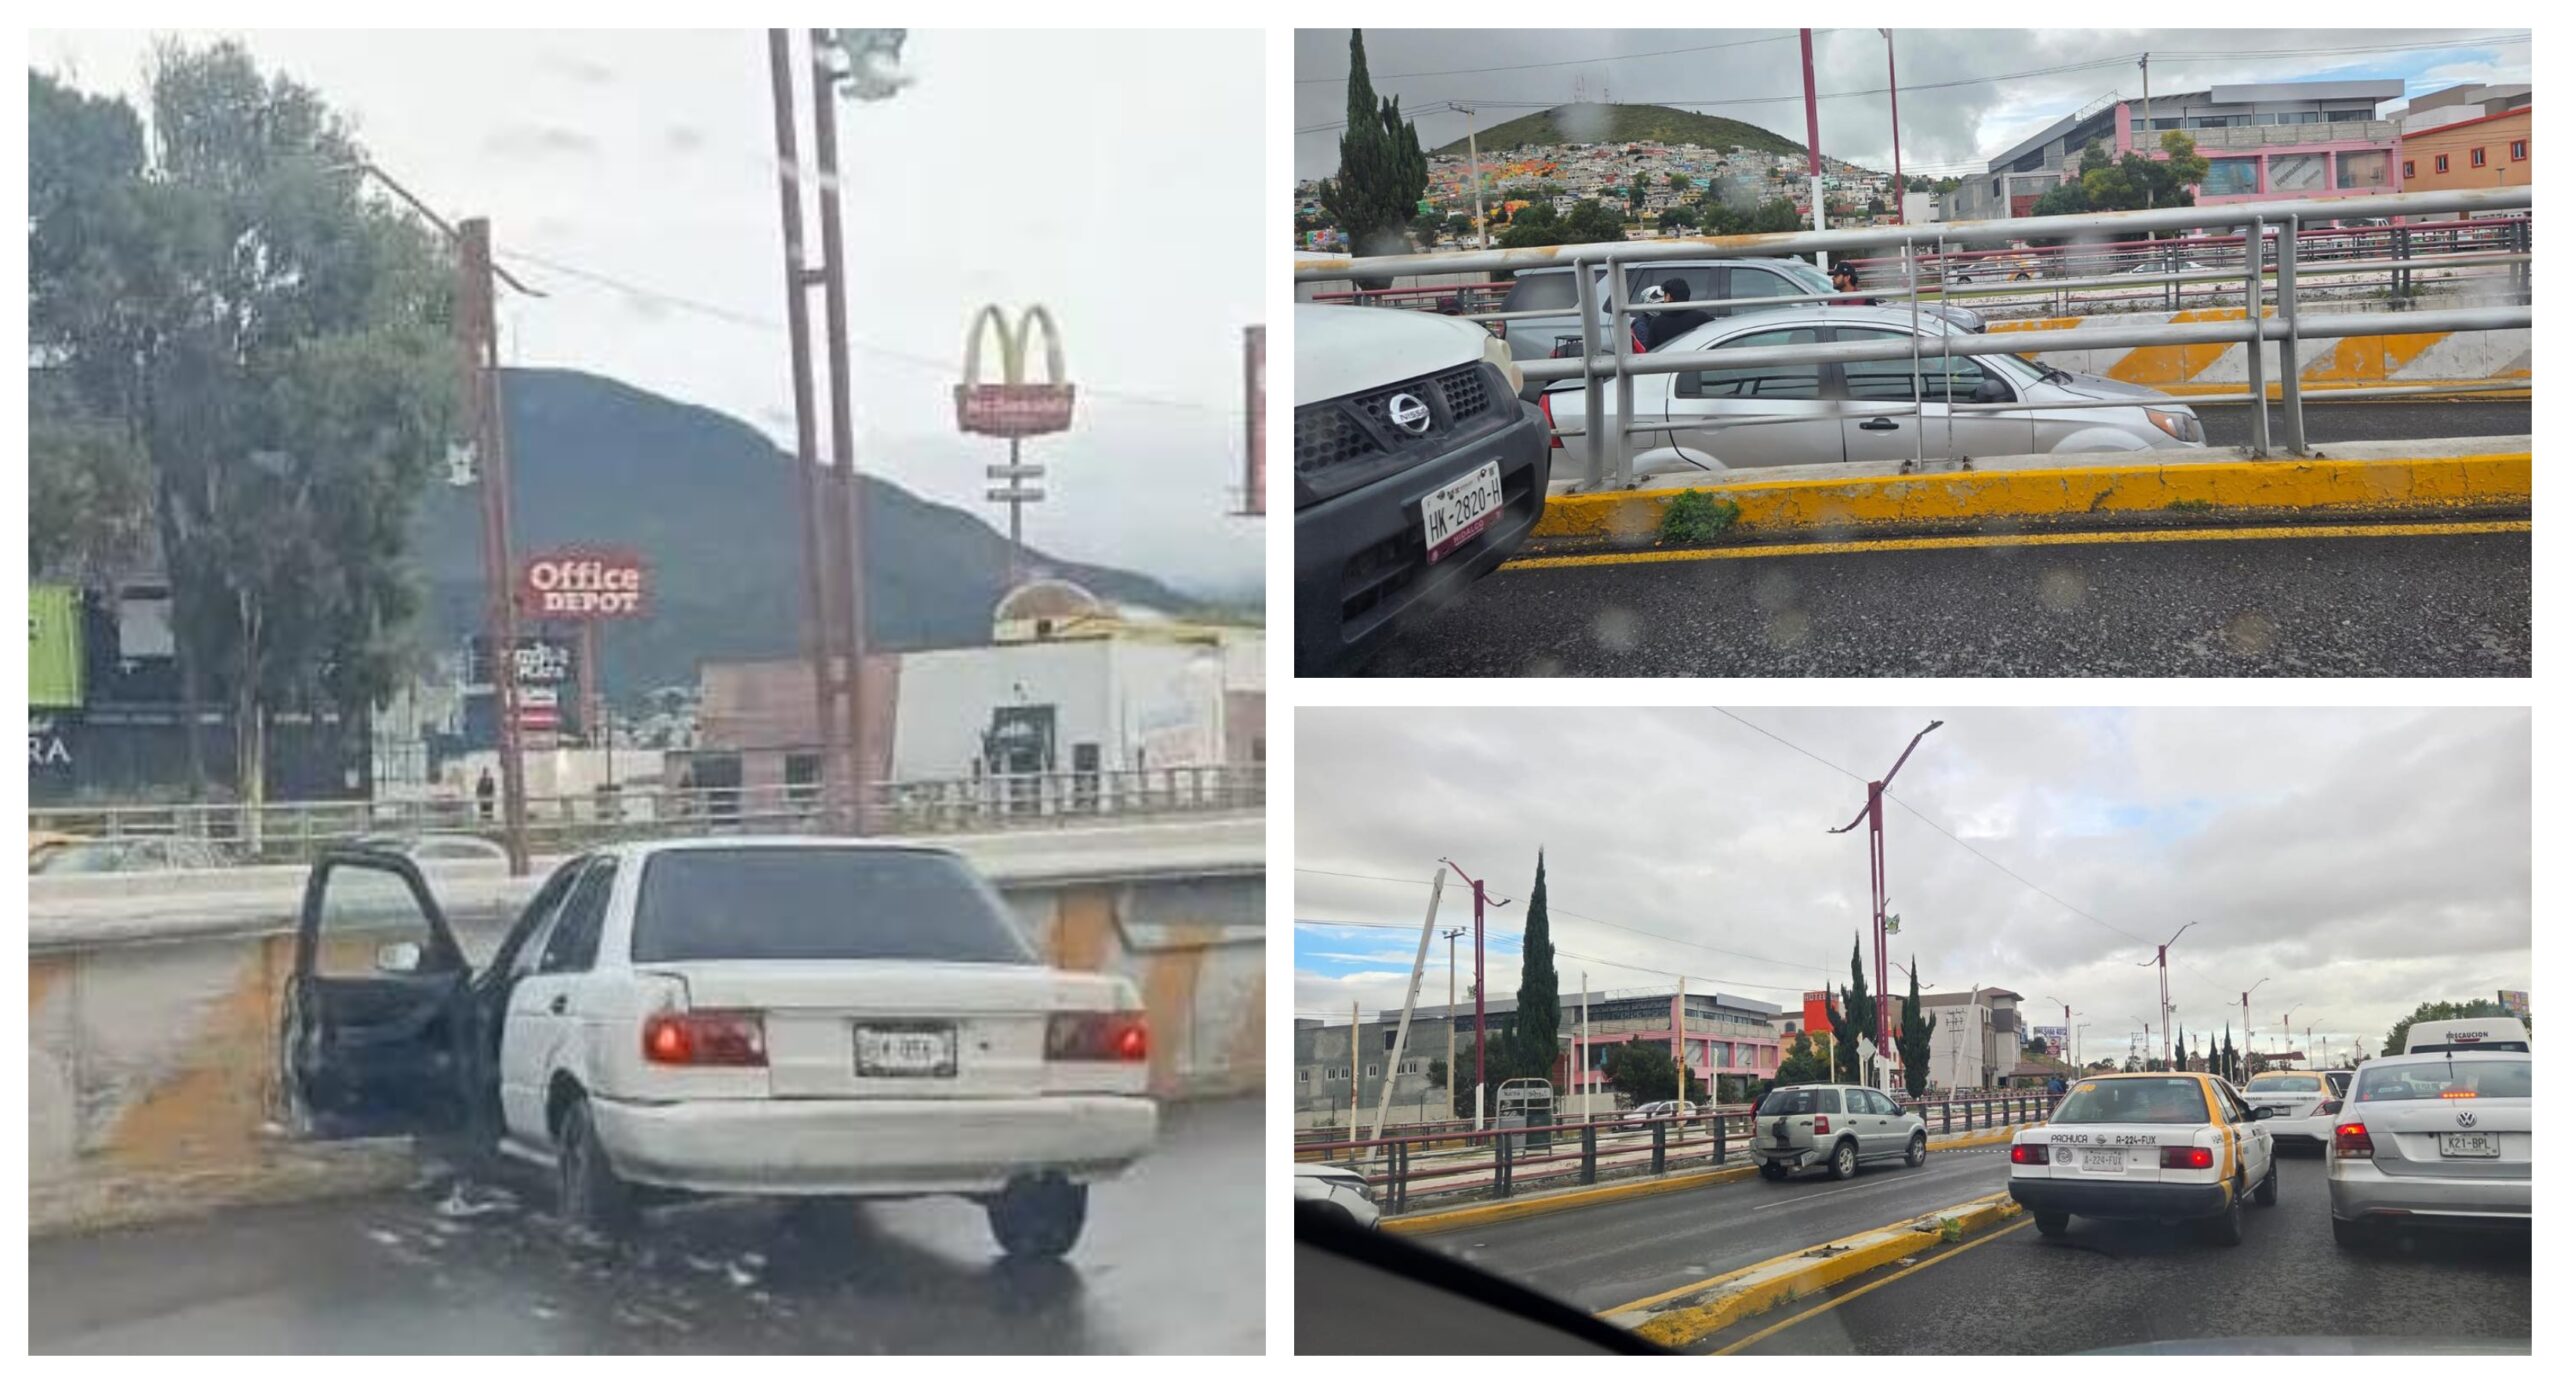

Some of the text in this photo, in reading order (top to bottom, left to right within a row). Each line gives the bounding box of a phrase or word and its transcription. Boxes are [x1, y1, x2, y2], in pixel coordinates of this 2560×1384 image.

[1429, 478, 1501, 542] HK-2820-H
[1453, 520, 1485, 544] HIDALGO
[530, 561, 639, 590] Office
[544, 592, 639, 612] DEPOT
[1805, 993, 1825, 1001] HOTEL
[2051, 1134, 2156, 1145] PACHUCA A-224-FUX
[2449, 1137, 2491, 1150] K21-BPL
